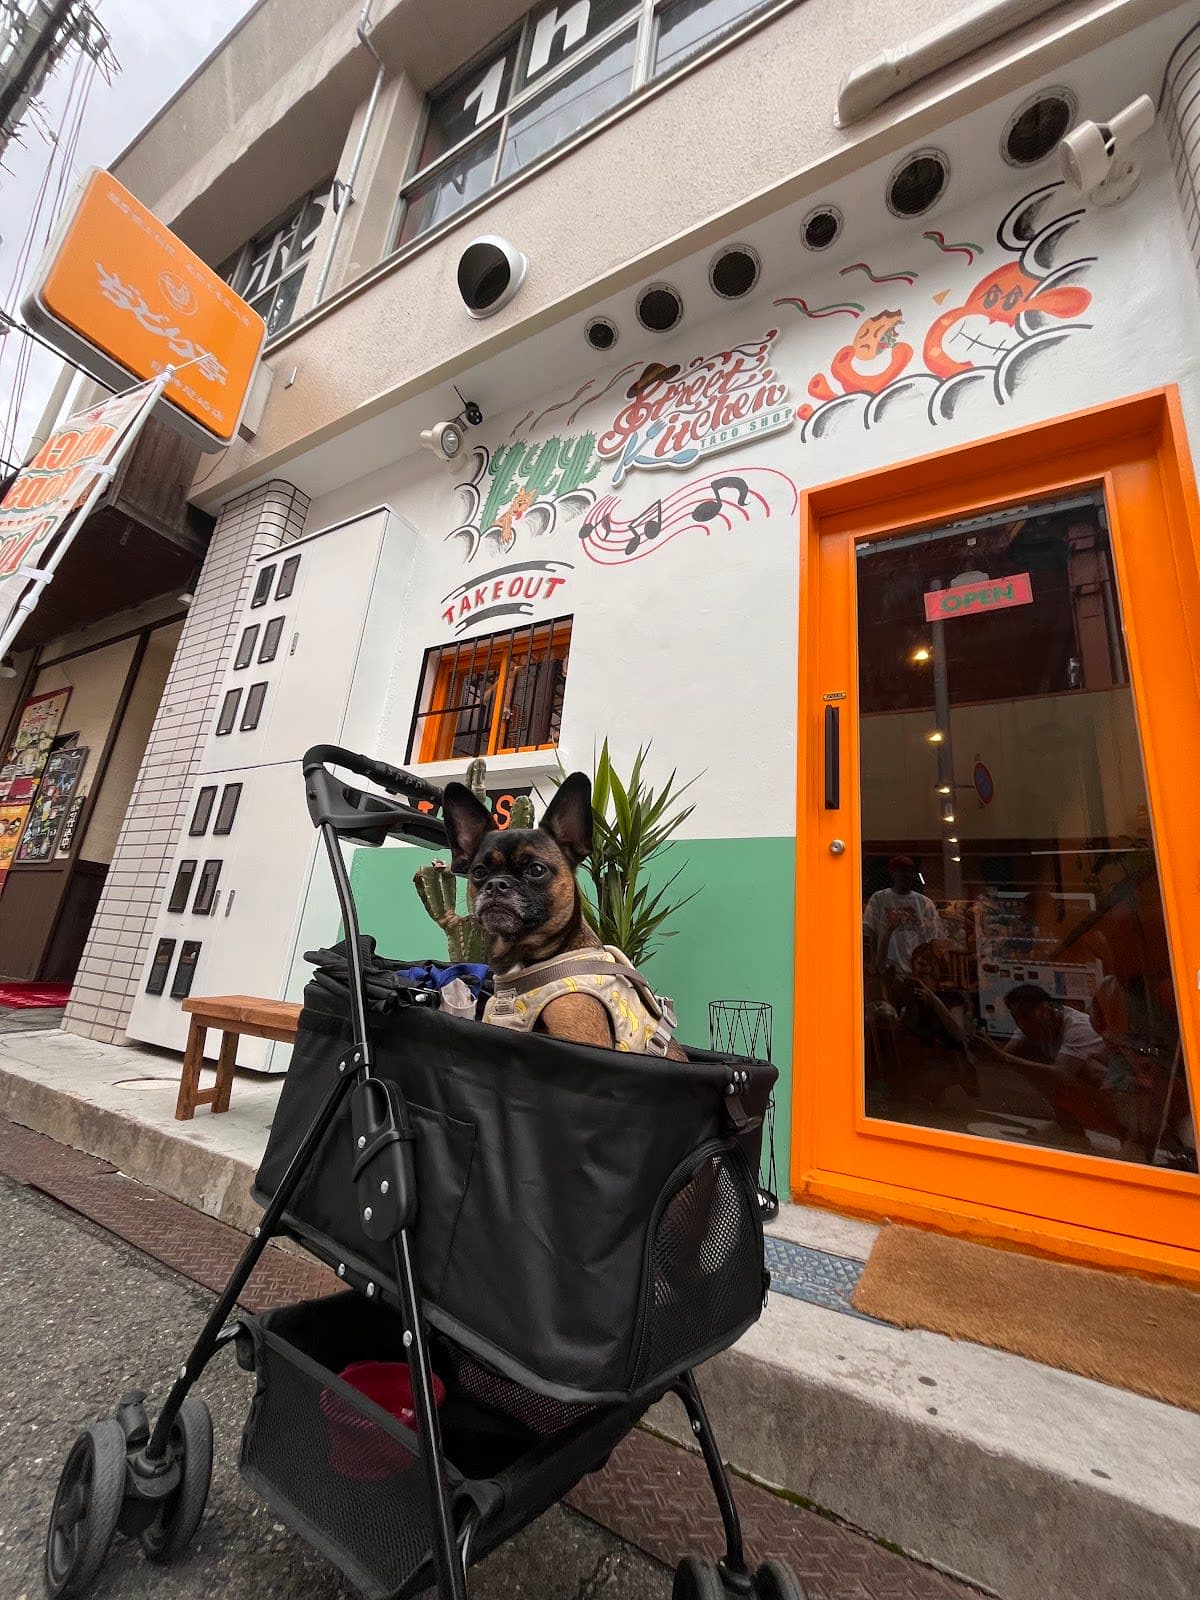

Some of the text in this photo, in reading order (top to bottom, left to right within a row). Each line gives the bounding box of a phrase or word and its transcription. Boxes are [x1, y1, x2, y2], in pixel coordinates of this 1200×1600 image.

[598, 352, 752, 455] Street
[612, 383, 786, 482] Kitchen
[701, 408, 793, 449] TACO SHOP
[441, 576, 566, 625] TAKEOUT
[941, 583, 1014, 613] OPEN
